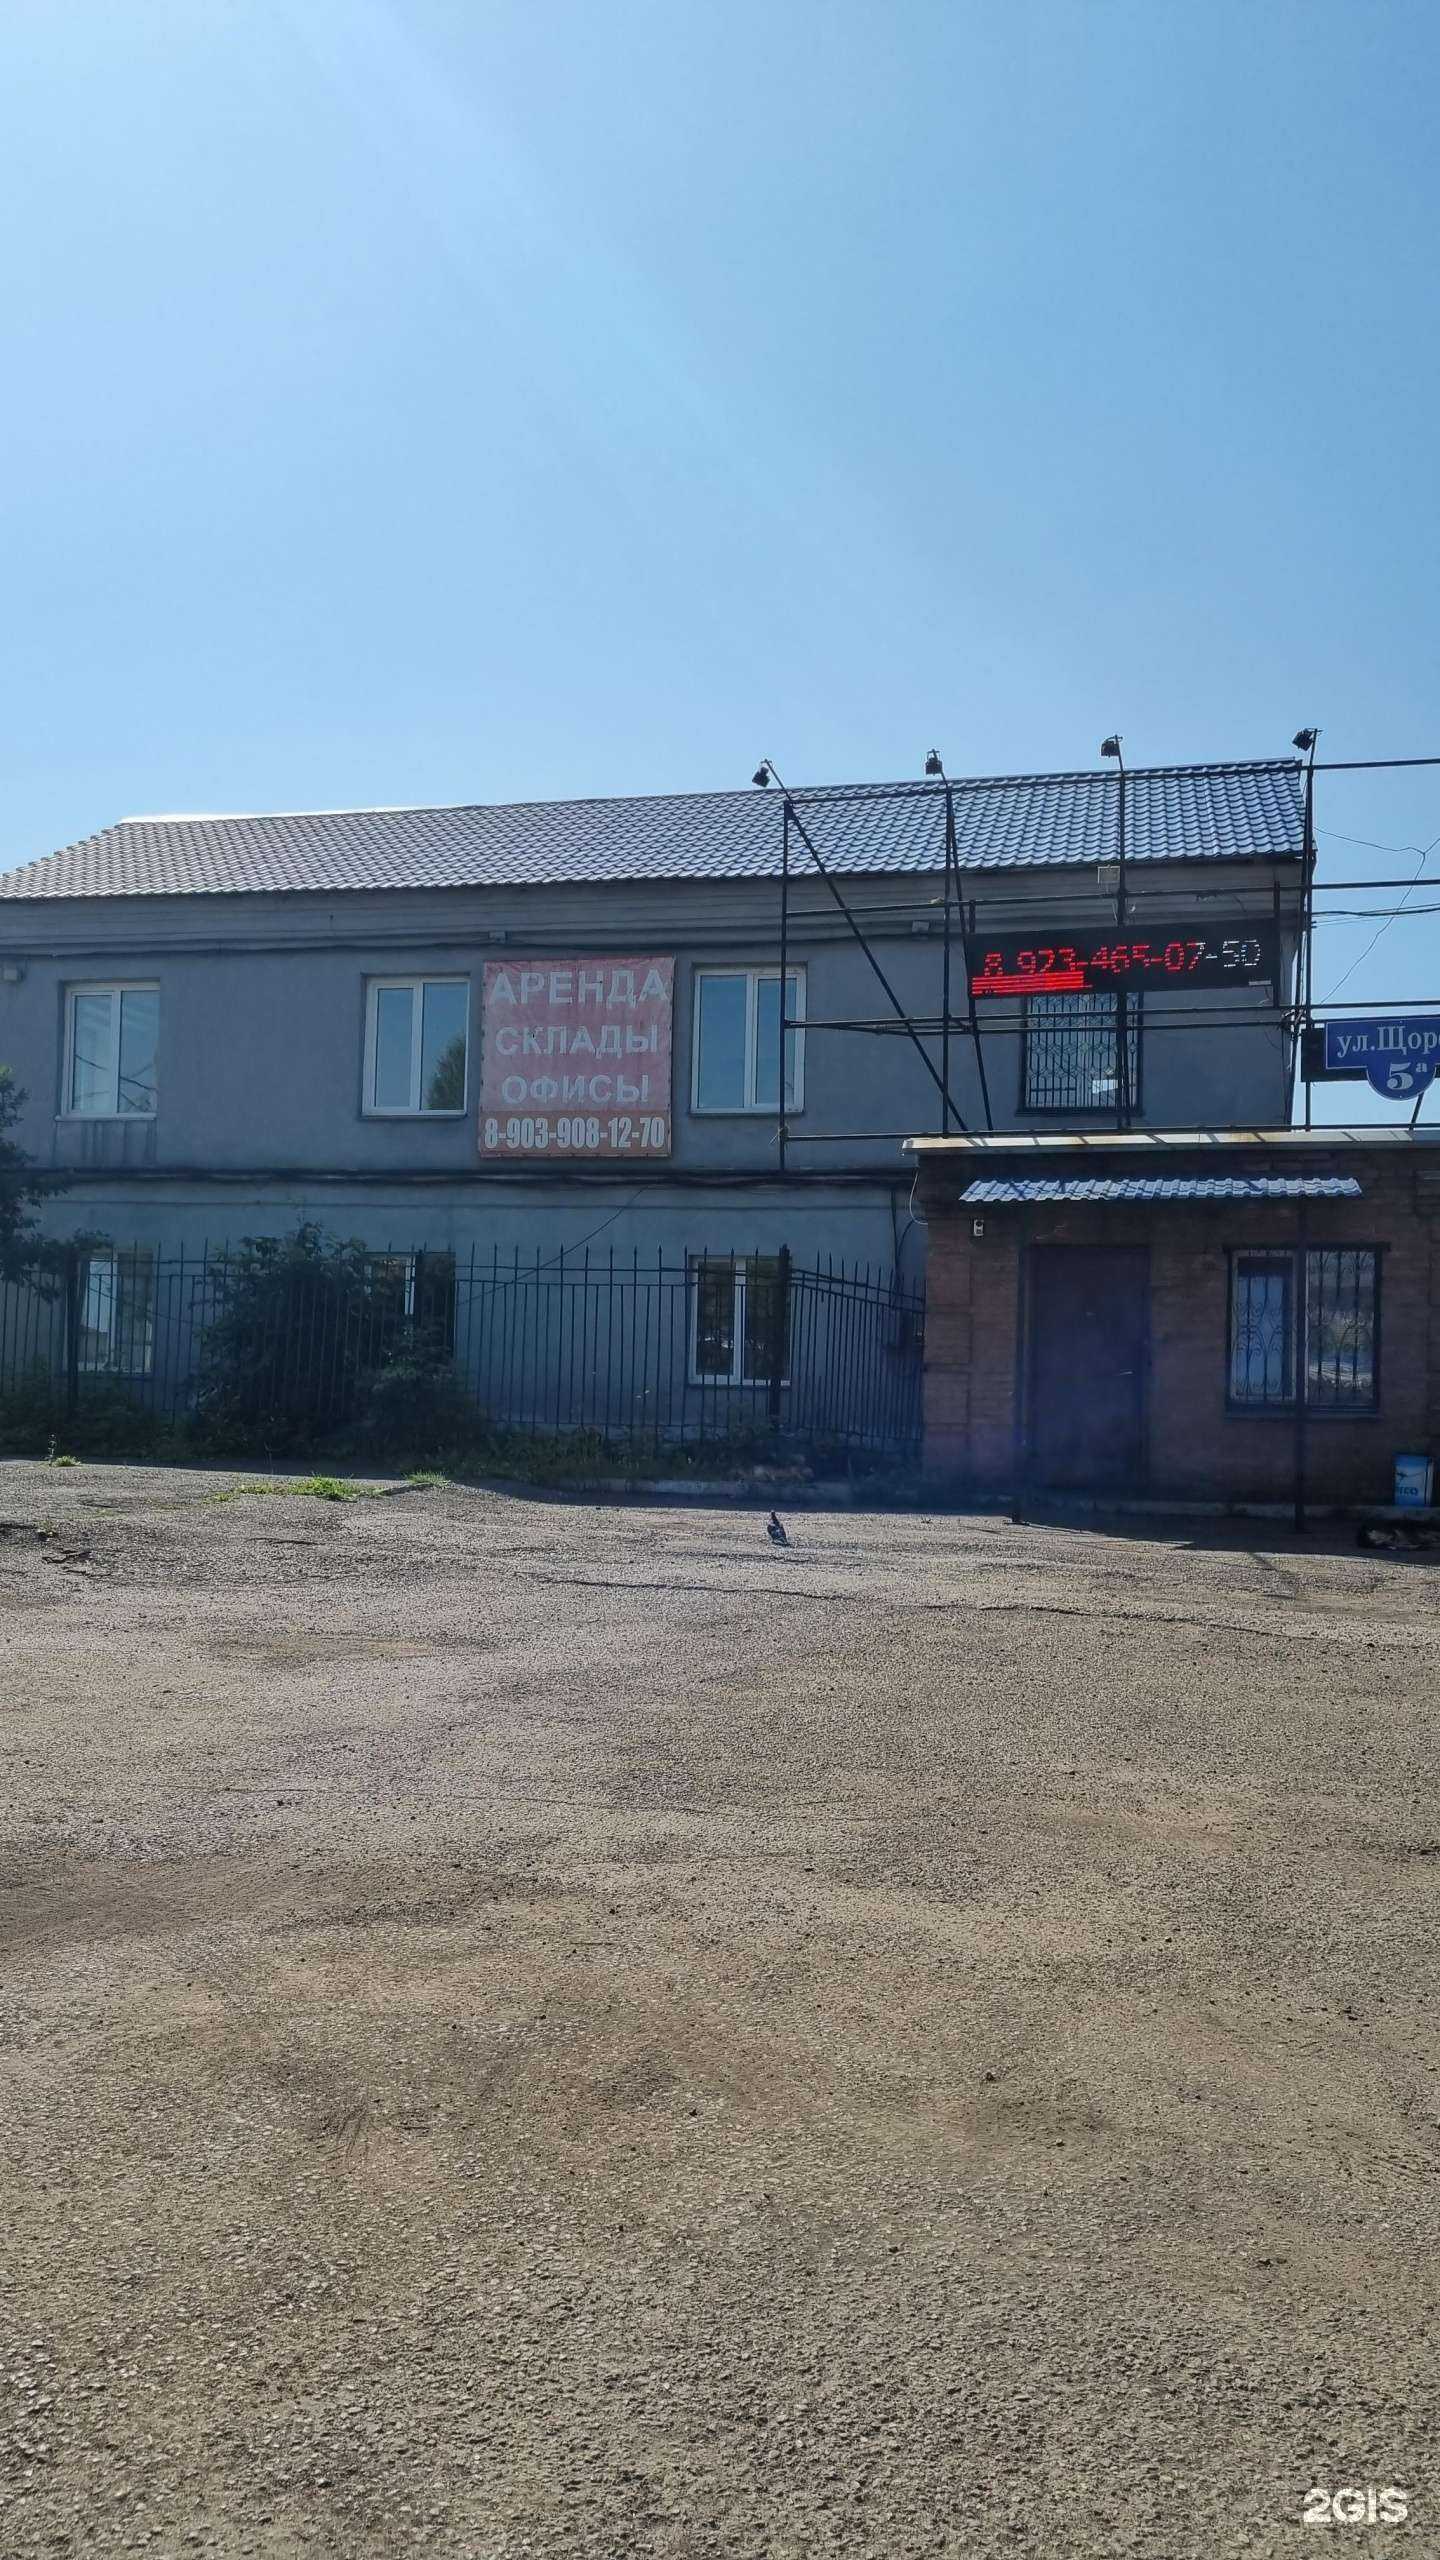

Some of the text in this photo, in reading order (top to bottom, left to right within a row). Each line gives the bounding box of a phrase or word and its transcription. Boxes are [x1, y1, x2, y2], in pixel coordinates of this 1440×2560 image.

[489, 968, 671, 1009] АРЕНДА
[495, 1024, 658, 1060] СКЛАДЫ
[1336, 1025, 1440, 1058] ул.Щор
[502, 1074, 650, 1104] ОФИСЫ
[484, 1117, 666, 1149] 8-903-908-12-70
